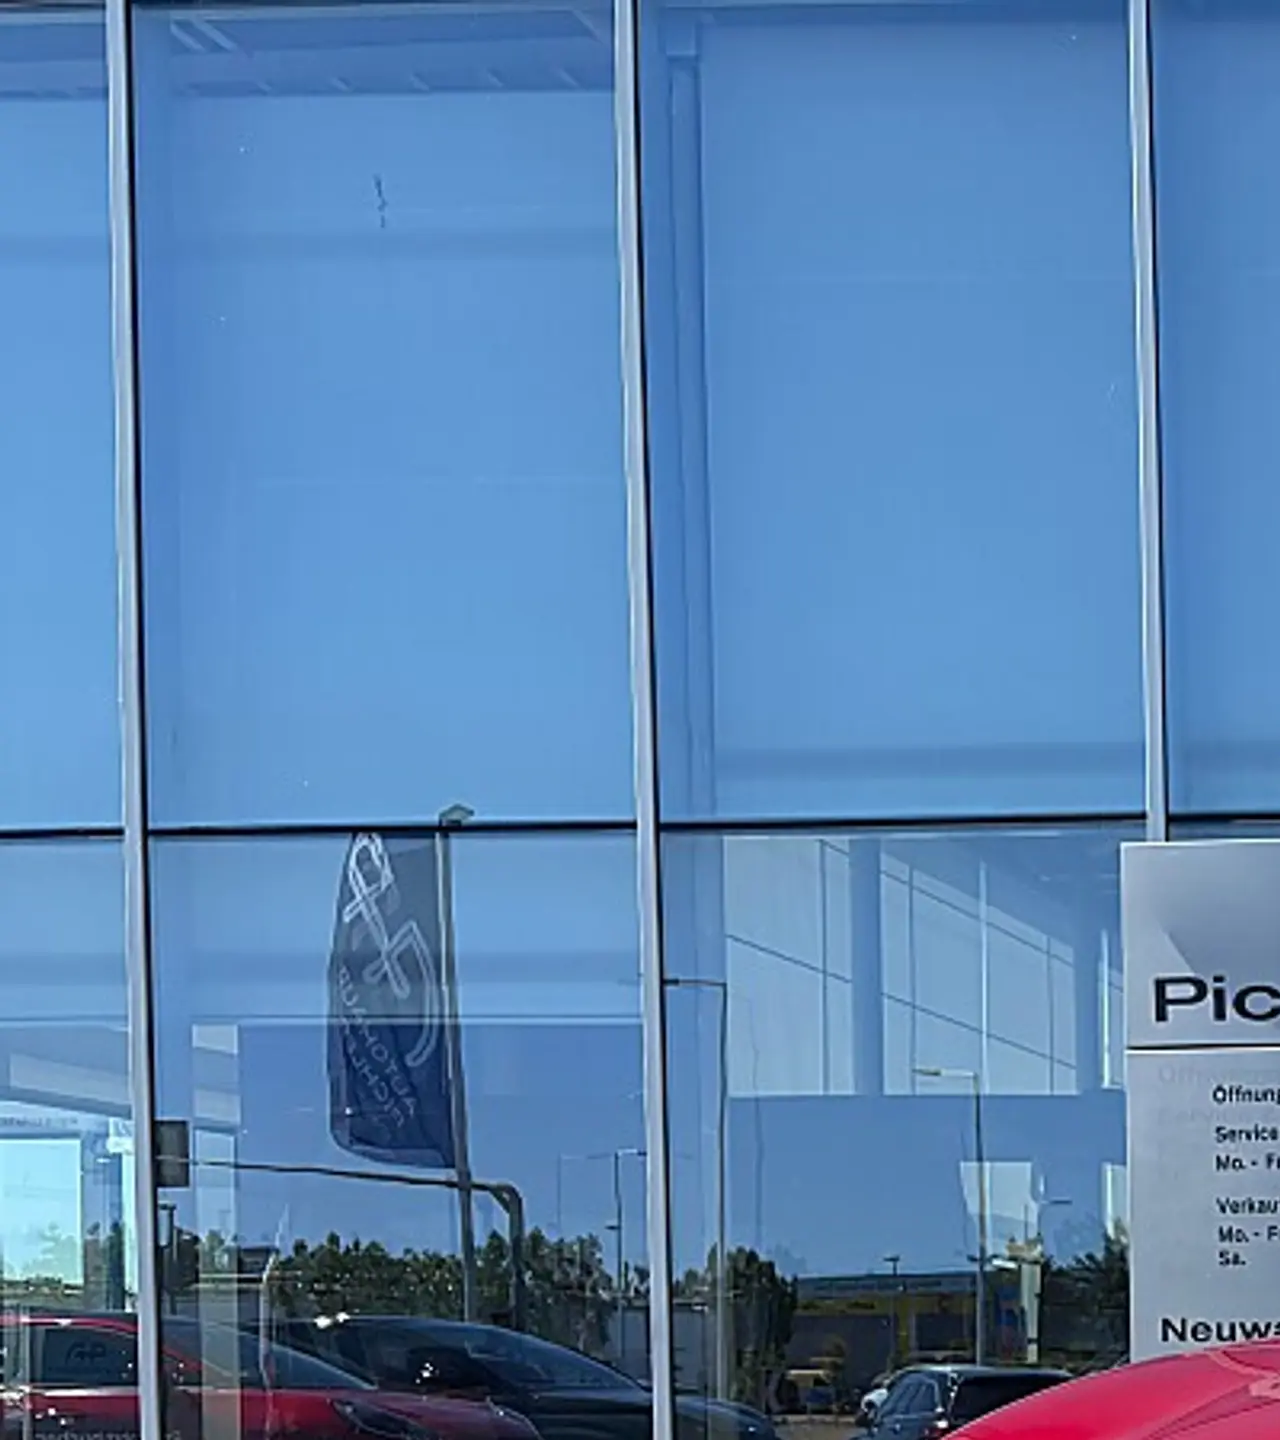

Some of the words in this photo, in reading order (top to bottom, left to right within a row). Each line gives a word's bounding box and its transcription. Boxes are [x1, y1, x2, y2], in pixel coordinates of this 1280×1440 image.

[1215, 1124, 1278, 1143] Service
[1216, 1154, 1246, 1171] Mo.
[1218, 1225, 1249, 1243] Mo.
[1218, 1249, 1247, 1267] Sa.
